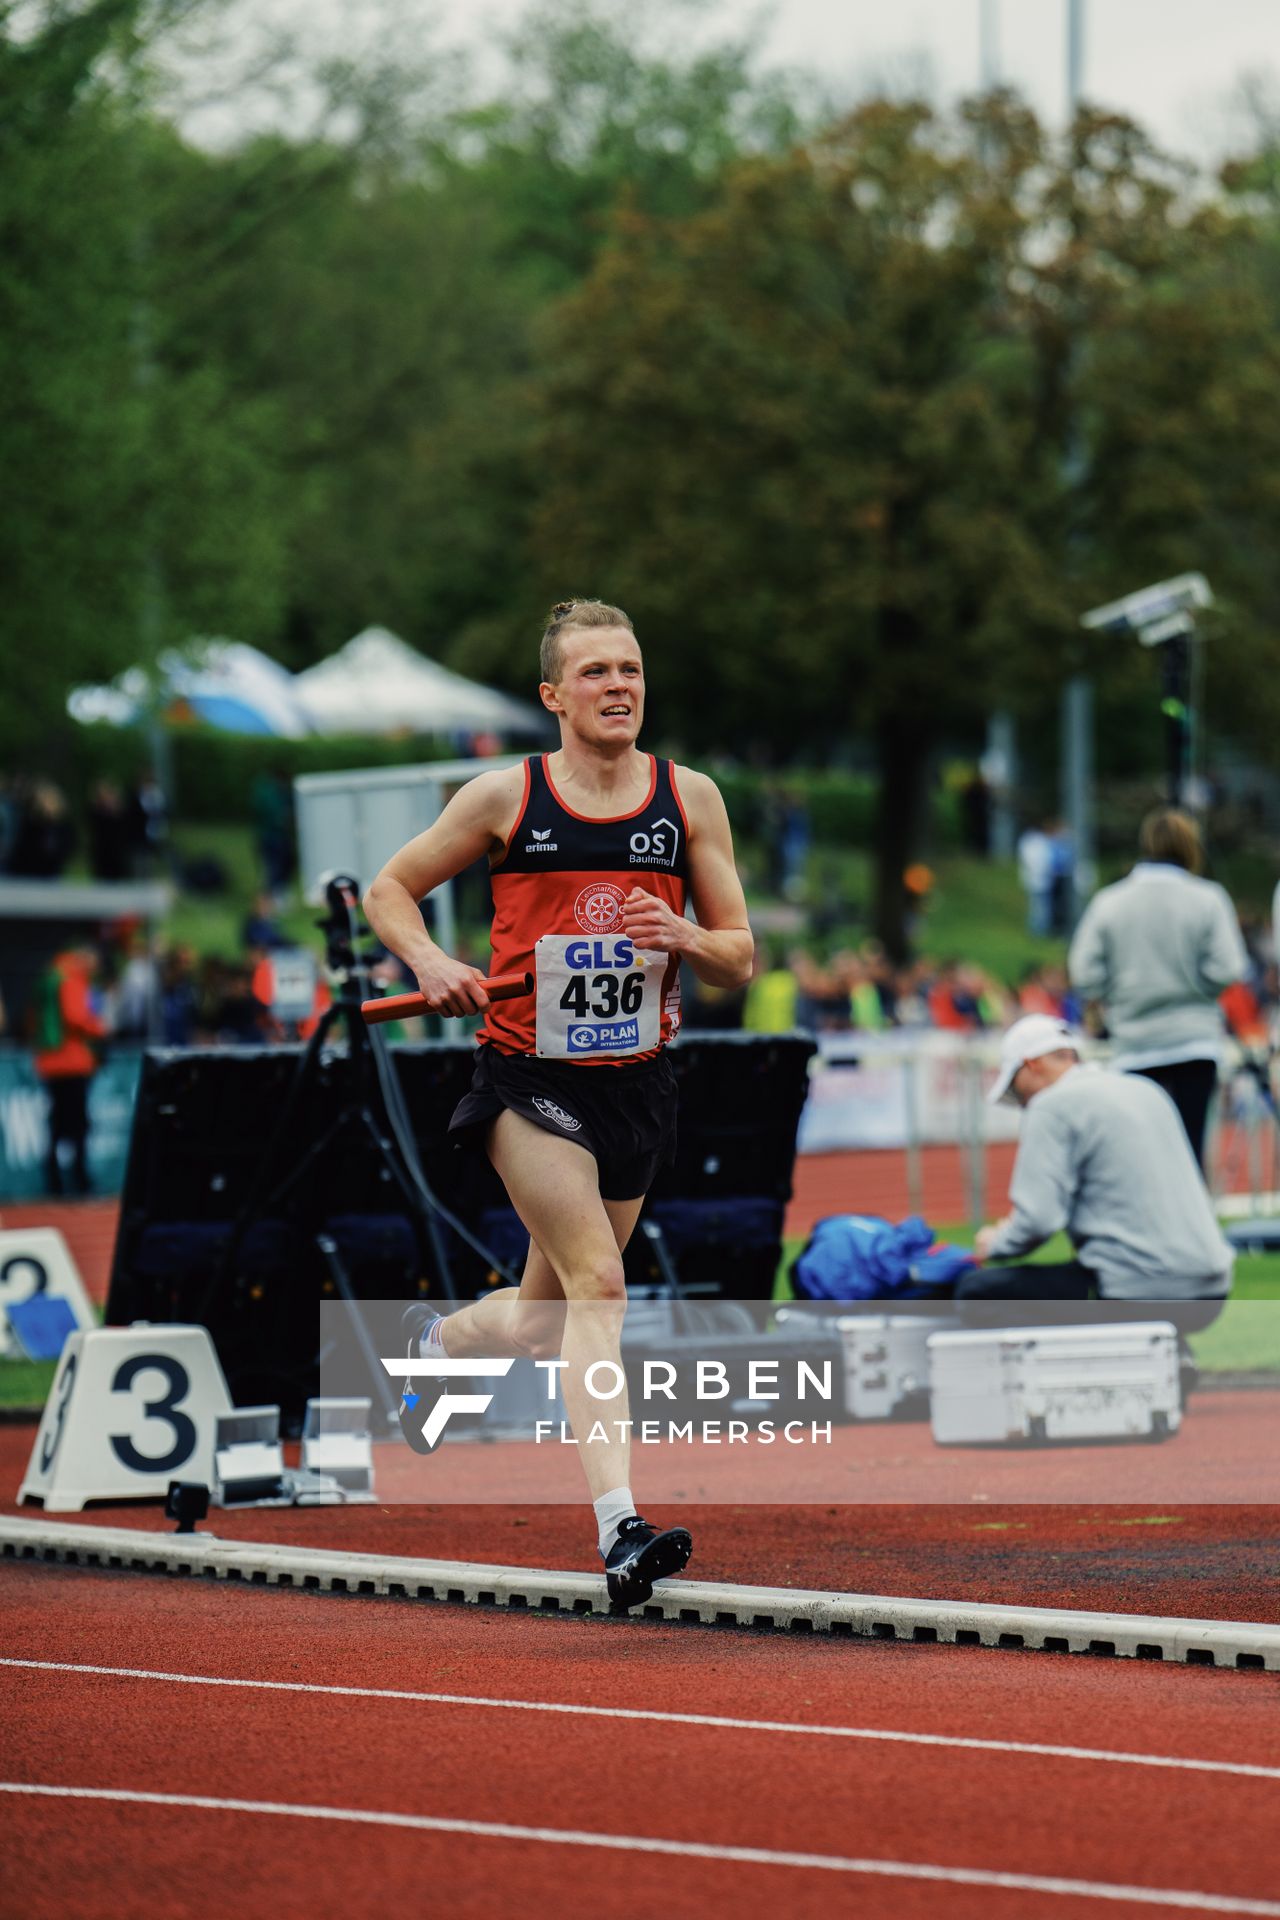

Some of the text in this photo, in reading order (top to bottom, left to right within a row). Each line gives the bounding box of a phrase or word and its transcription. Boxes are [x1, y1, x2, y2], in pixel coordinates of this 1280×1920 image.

[525, 842, 558, 853] erima
[629, 832, 666, 855] OS
[559, 972, 646, 1018] 436
[600, 1024, 637, 1040] PLAN
[600, 1039, 637, 1047] INTERNATIONAL
[109, 1354, 198, 1474] 3
